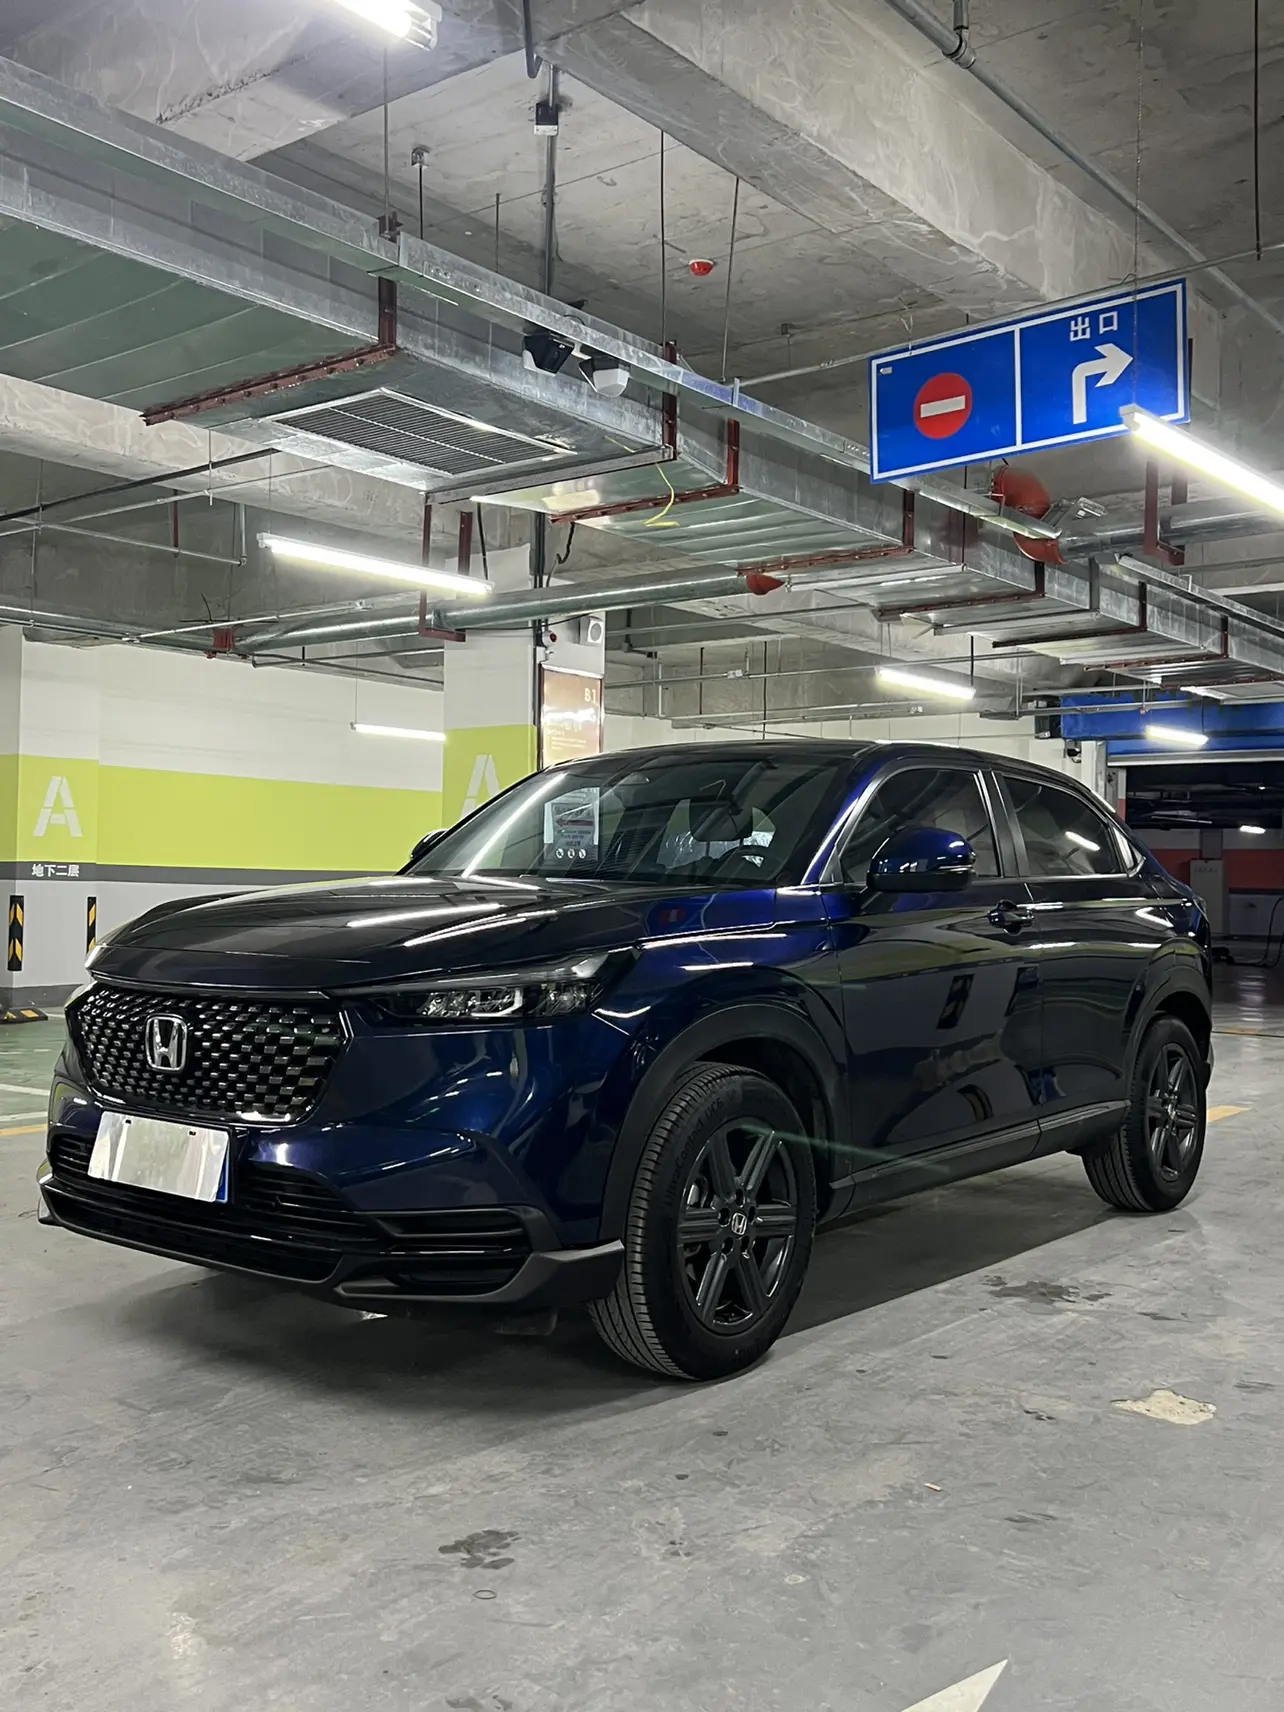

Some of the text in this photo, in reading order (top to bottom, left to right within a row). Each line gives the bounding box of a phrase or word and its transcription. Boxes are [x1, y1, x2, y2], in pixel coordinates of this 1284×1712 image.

[1070, 311, 1118, 342] 出口
[584, 687, 597, 704] B1
[33, 775, 83, 837] A
[31, 863, 80, 878] 地下二层
